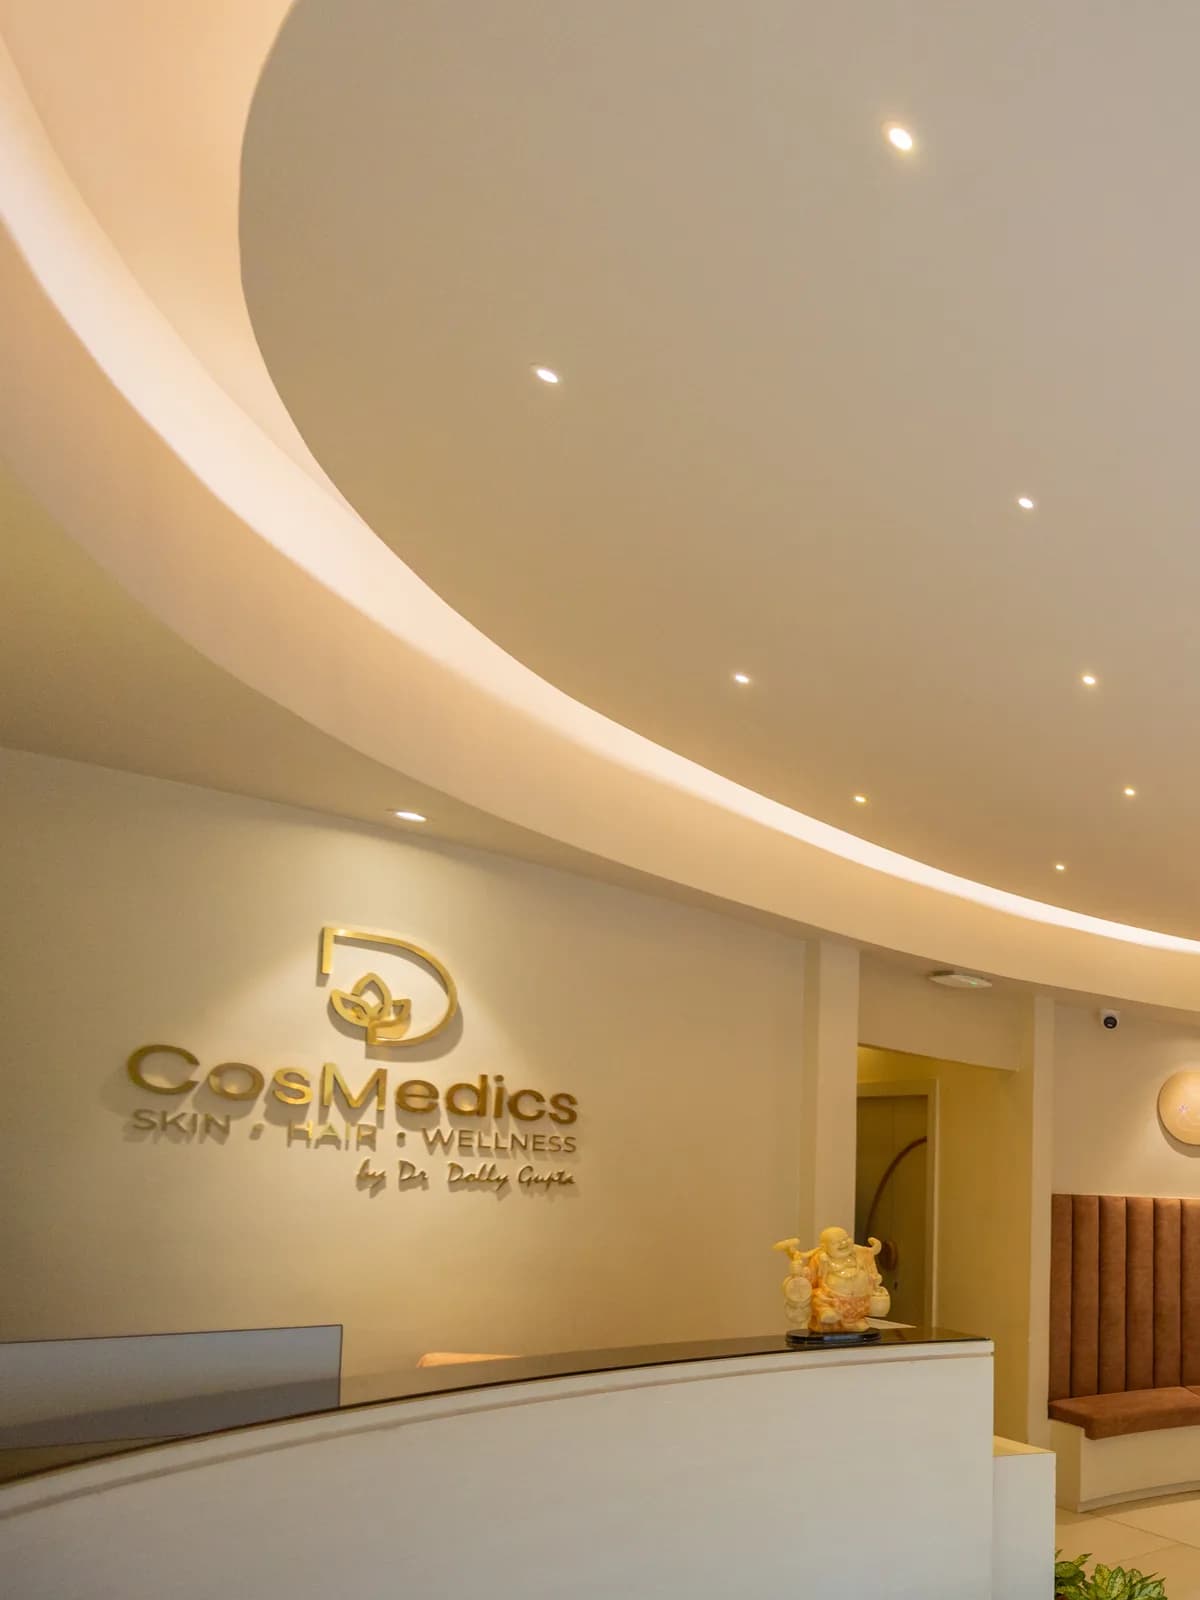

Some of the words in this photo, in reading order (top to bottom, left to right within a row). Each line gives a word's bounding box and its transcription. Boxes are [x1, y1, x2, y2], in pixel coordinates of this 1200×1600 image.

[127, 1044, 578, 1125] CosMedics
[132, 1108, 230, 1135] SKIN
[287, 1120, 377, 1143] HAIR
[421, 1127, 577, 1153] WELLNESS
[357, 1159, 385, 1187] by
[399, 1160, 428, 1182] Dr
[447, 1162, 509, 1190] Dolly
[518, 1165, 576, 1191] Gupta
